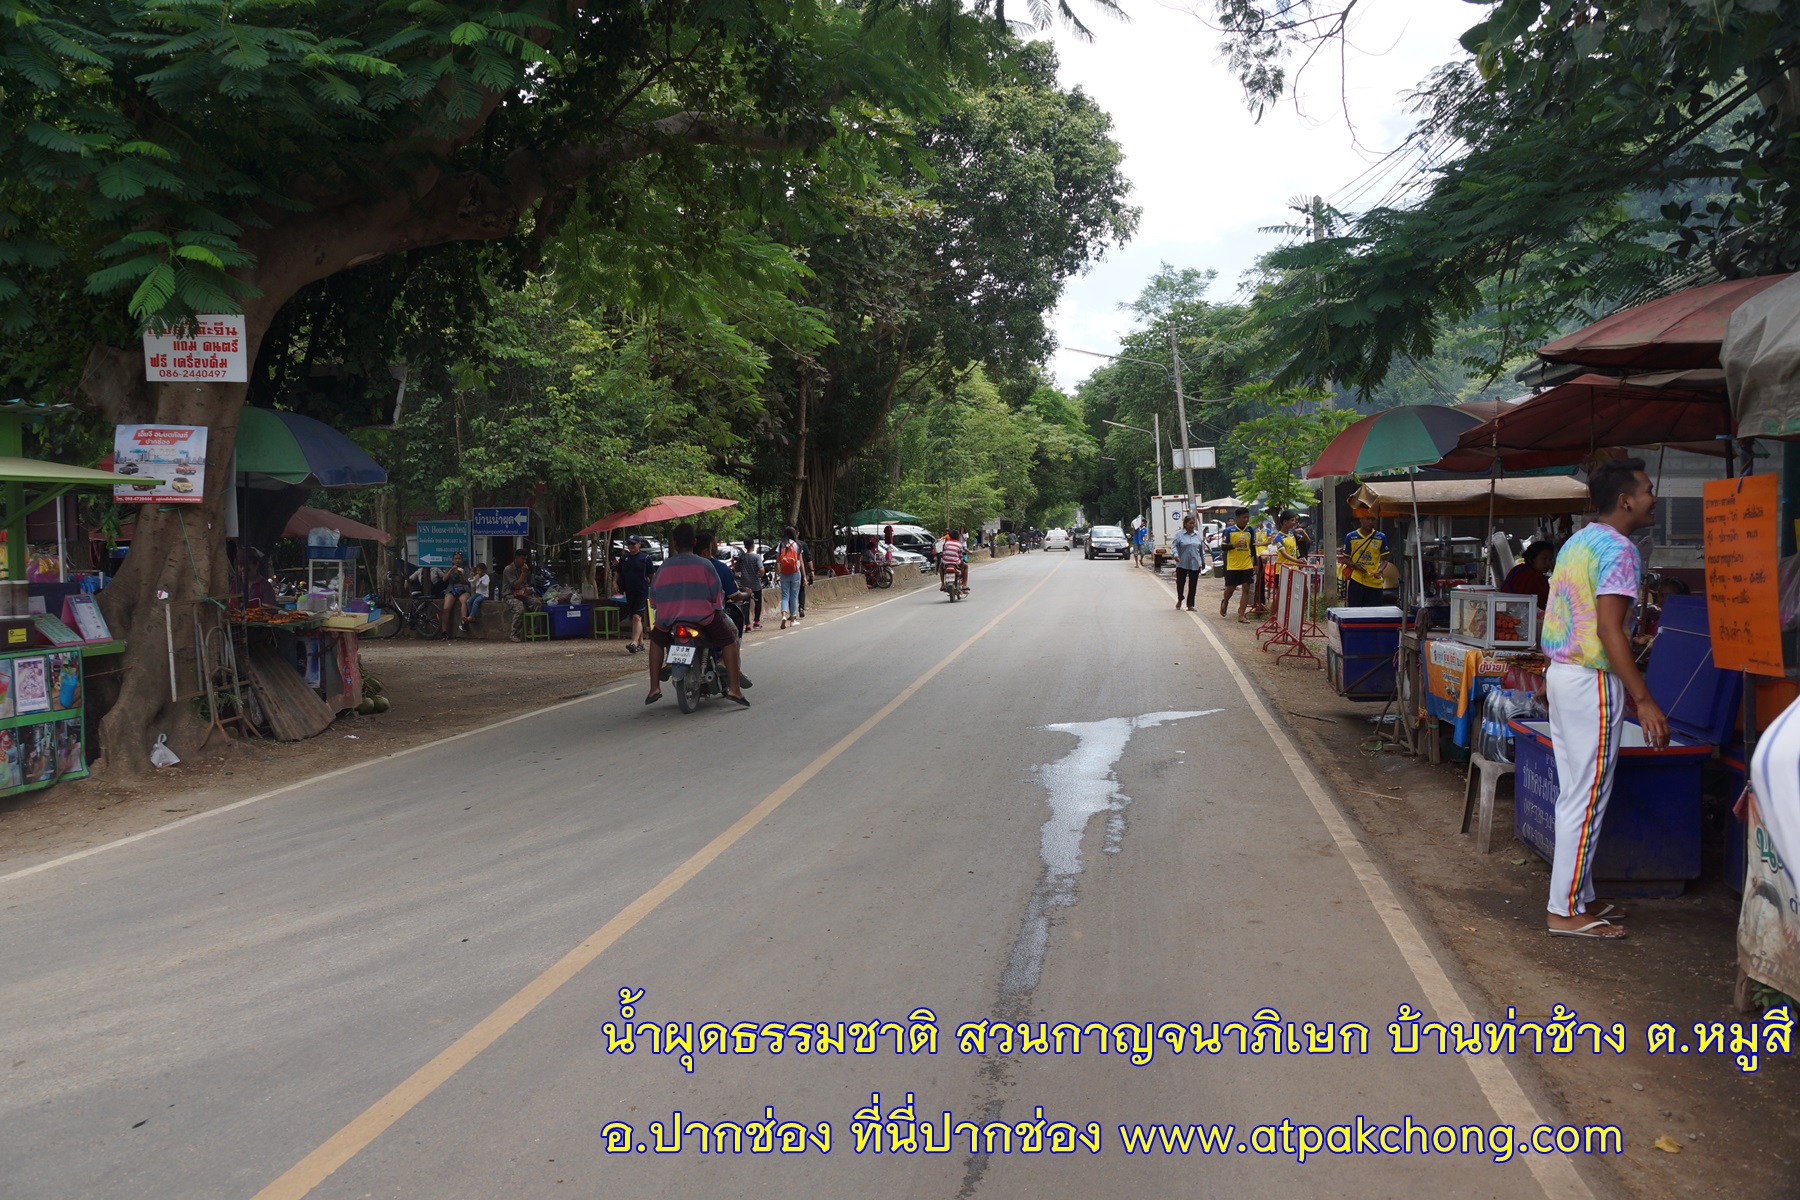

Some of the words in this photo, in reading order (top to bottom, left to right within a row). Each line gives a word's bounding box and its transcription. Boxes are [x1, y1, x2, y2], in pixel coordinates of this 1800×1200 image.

[173, 341, 197, 351] แถม
[203, 339, 239, 352] ดนตรี
[150, 353, 167, 368] ฟรี
[173, 352, 228, 368] เครื่องดื่ม
[159, 370, 226, 378] 086-2440497
[475, 509, 514, 528] บ้านน้ำผุด
